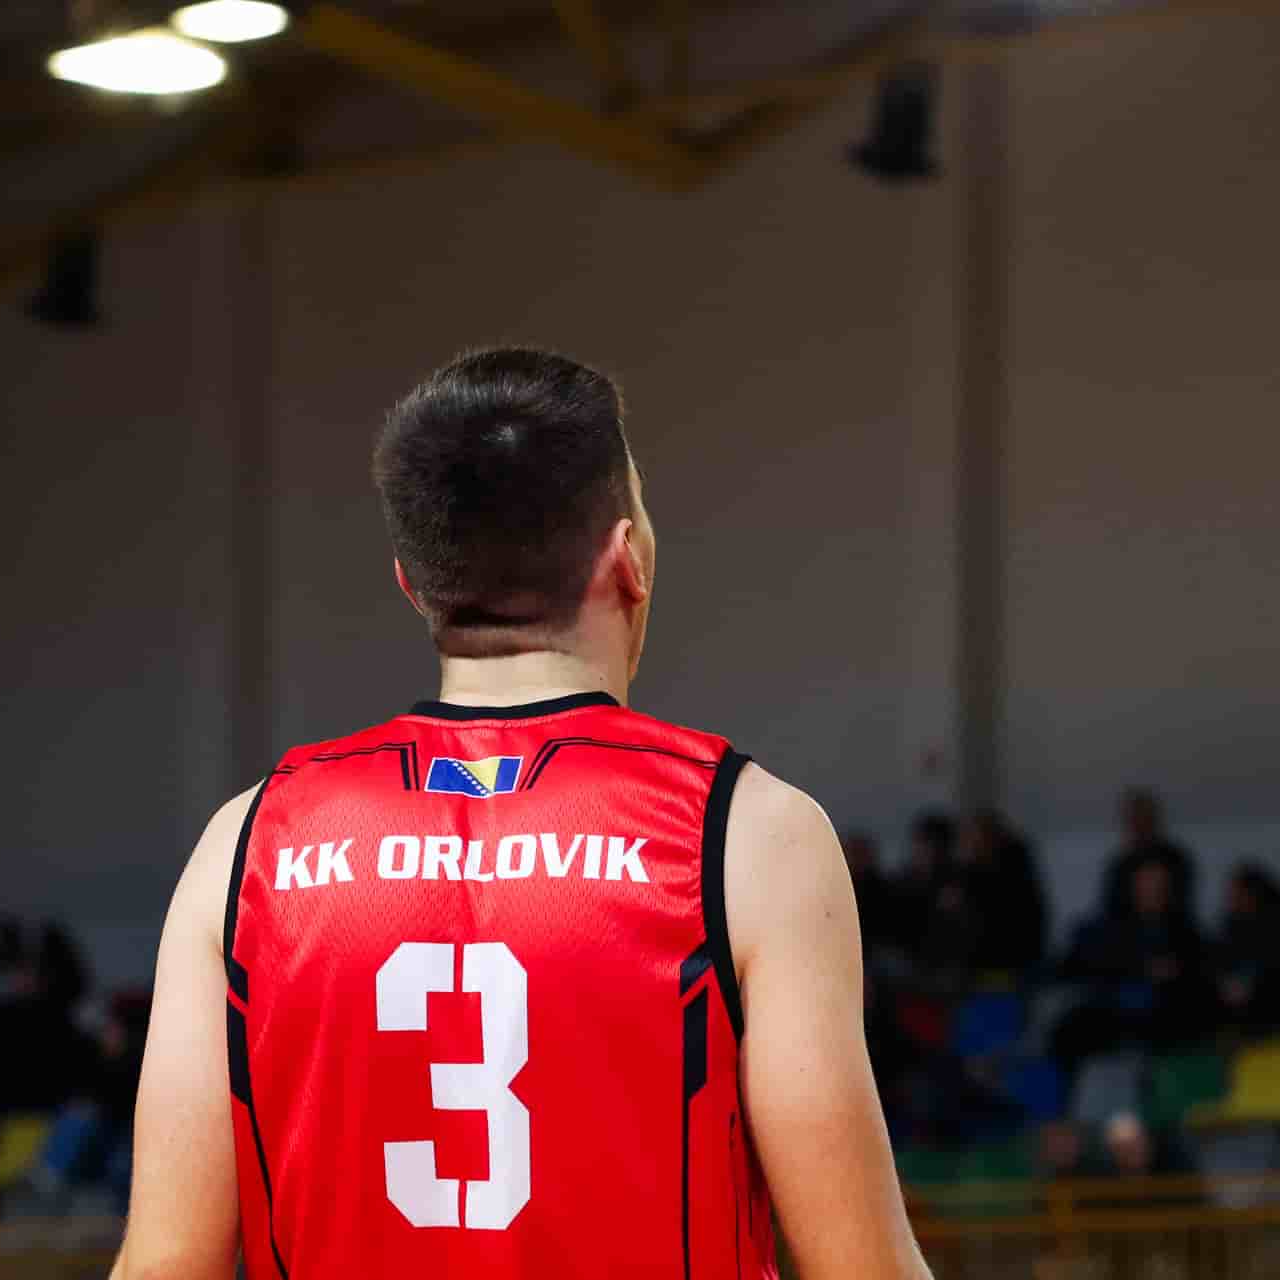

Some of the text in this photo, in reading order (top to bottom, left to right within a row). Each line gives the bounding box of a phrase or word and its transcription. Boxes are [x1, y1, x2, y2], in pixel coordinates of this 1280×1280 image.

[274, 833, 650, 890] KK ORLOVIK
[376, 942, 531, 1230] 3
